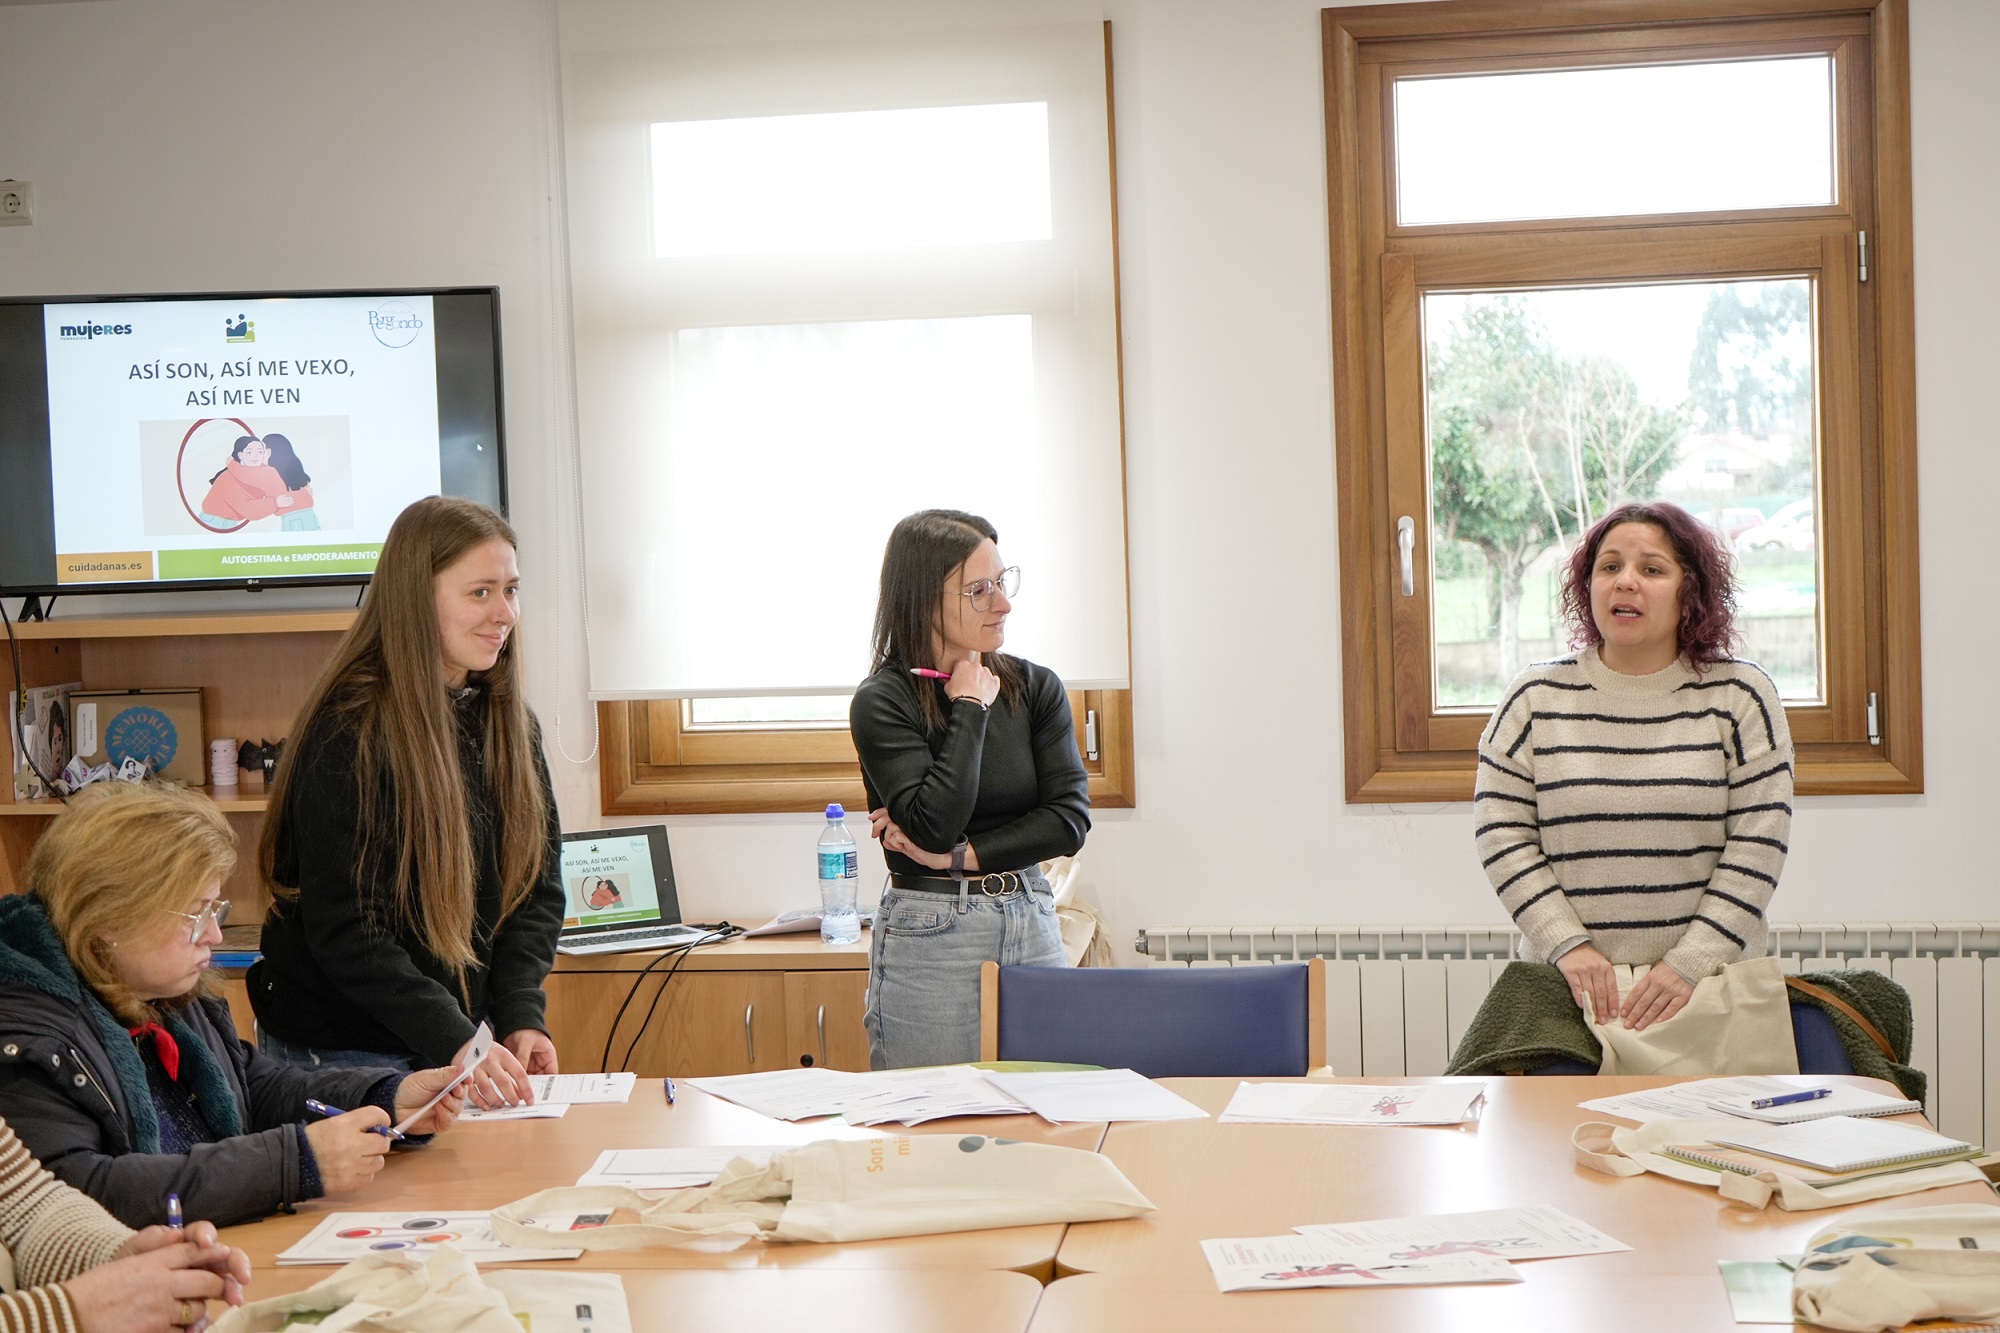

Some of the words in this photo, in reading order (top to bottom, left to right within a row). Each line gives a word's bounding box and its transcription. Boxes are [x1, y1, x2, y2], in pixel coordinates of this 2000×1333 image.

[129, 359, 161, 380] ASÍ
[165, 362, 215, 381] SON,
[220, 357, 253, 378] ASÍ
[258, 360, 289, 377] ME
[295, 358, 355, 377] VEXO,
[186, 385, 218, 406] ASÍ
[223, 389, 254, 405] ME
[260, 388, 300, 404] VEN
[68, 561, 142, 573] cuidadanas.es
[221, 553, 282, 565] AUTOESTIMA
[284, 555, 290, 563] e
[291, 550, 378, 562] EMPODERAMENTO
[112, 713, 169, 747] MEMORIA
[590, 857, 600, 865] ASÍ
[867, 1147, 884, 1173] Son
